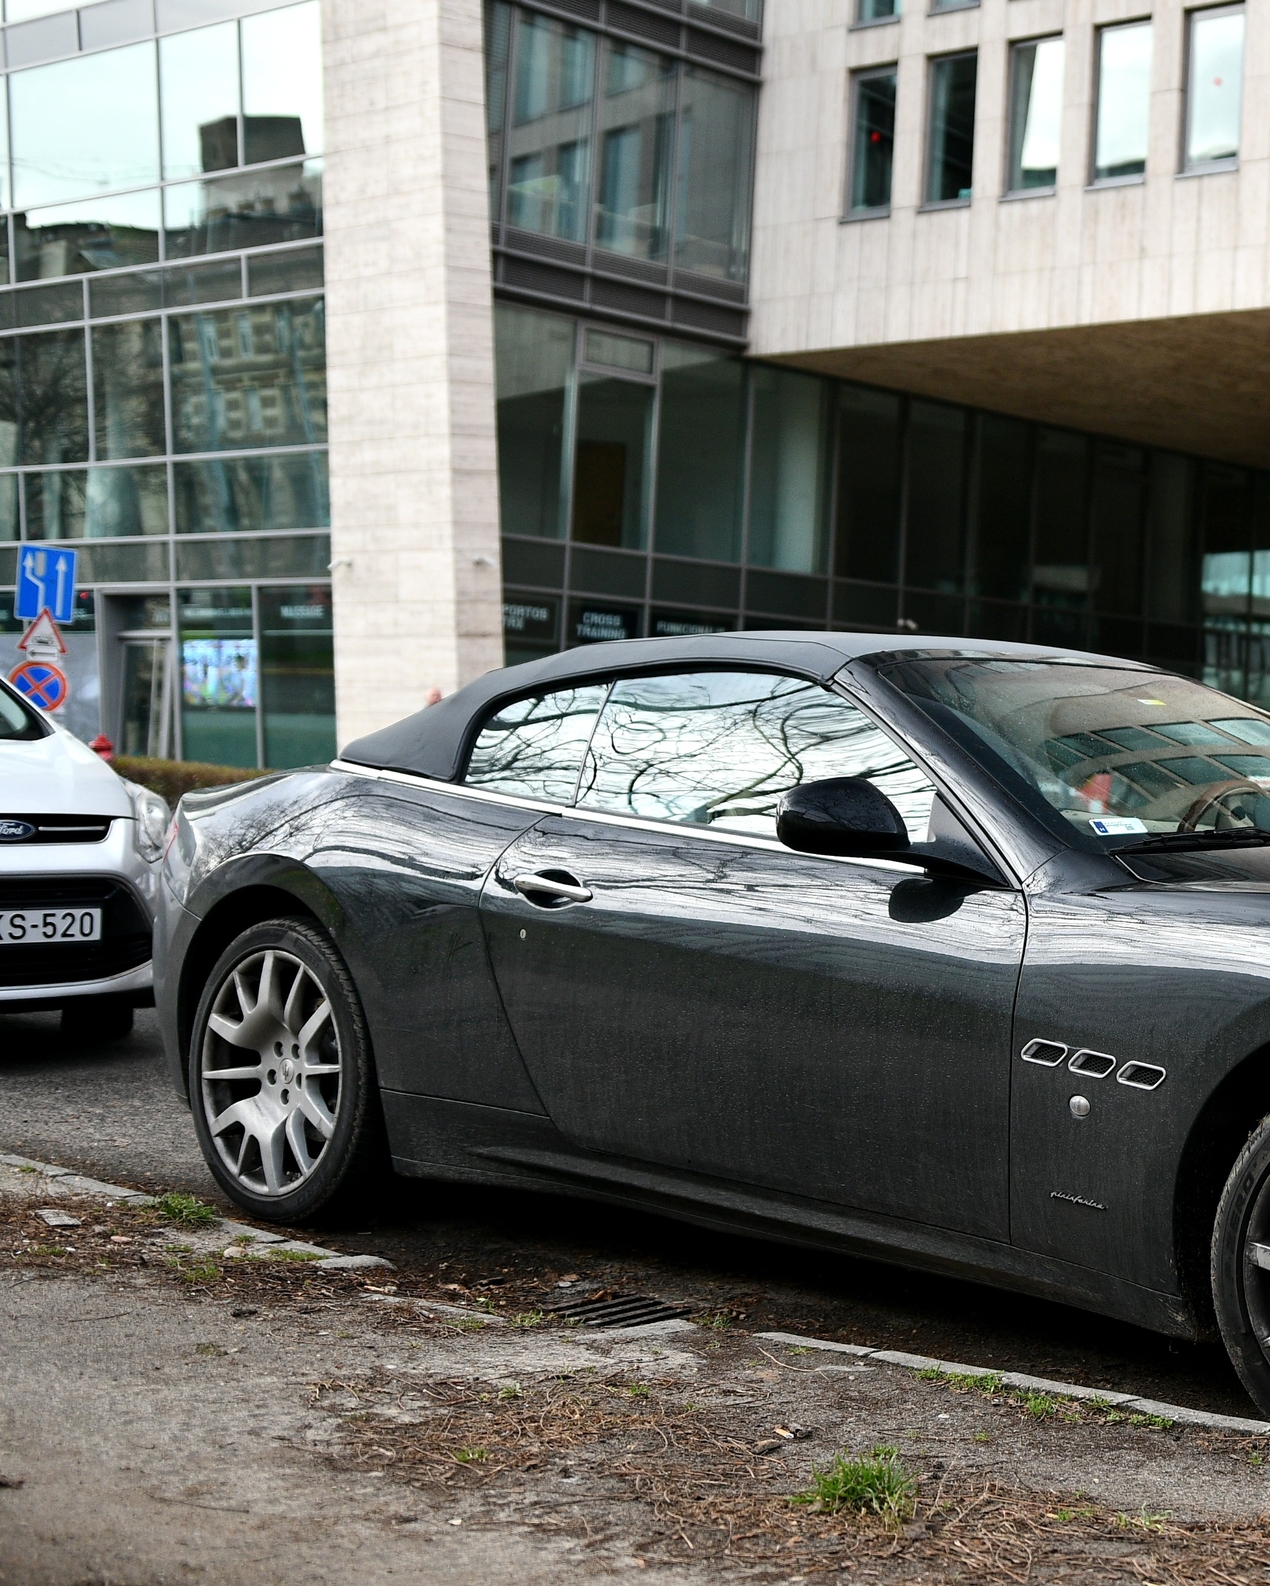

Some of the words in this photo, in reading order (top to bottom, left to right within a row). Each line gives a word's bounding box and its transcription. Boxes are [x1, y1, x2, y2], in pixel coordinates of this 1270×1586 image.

[583, 612, 621, 626] CROSS
[576, 624, 627, 638] TRAINING
[0, 822, 23, 835] Ford
[0, 911, 95, 940] S-520
